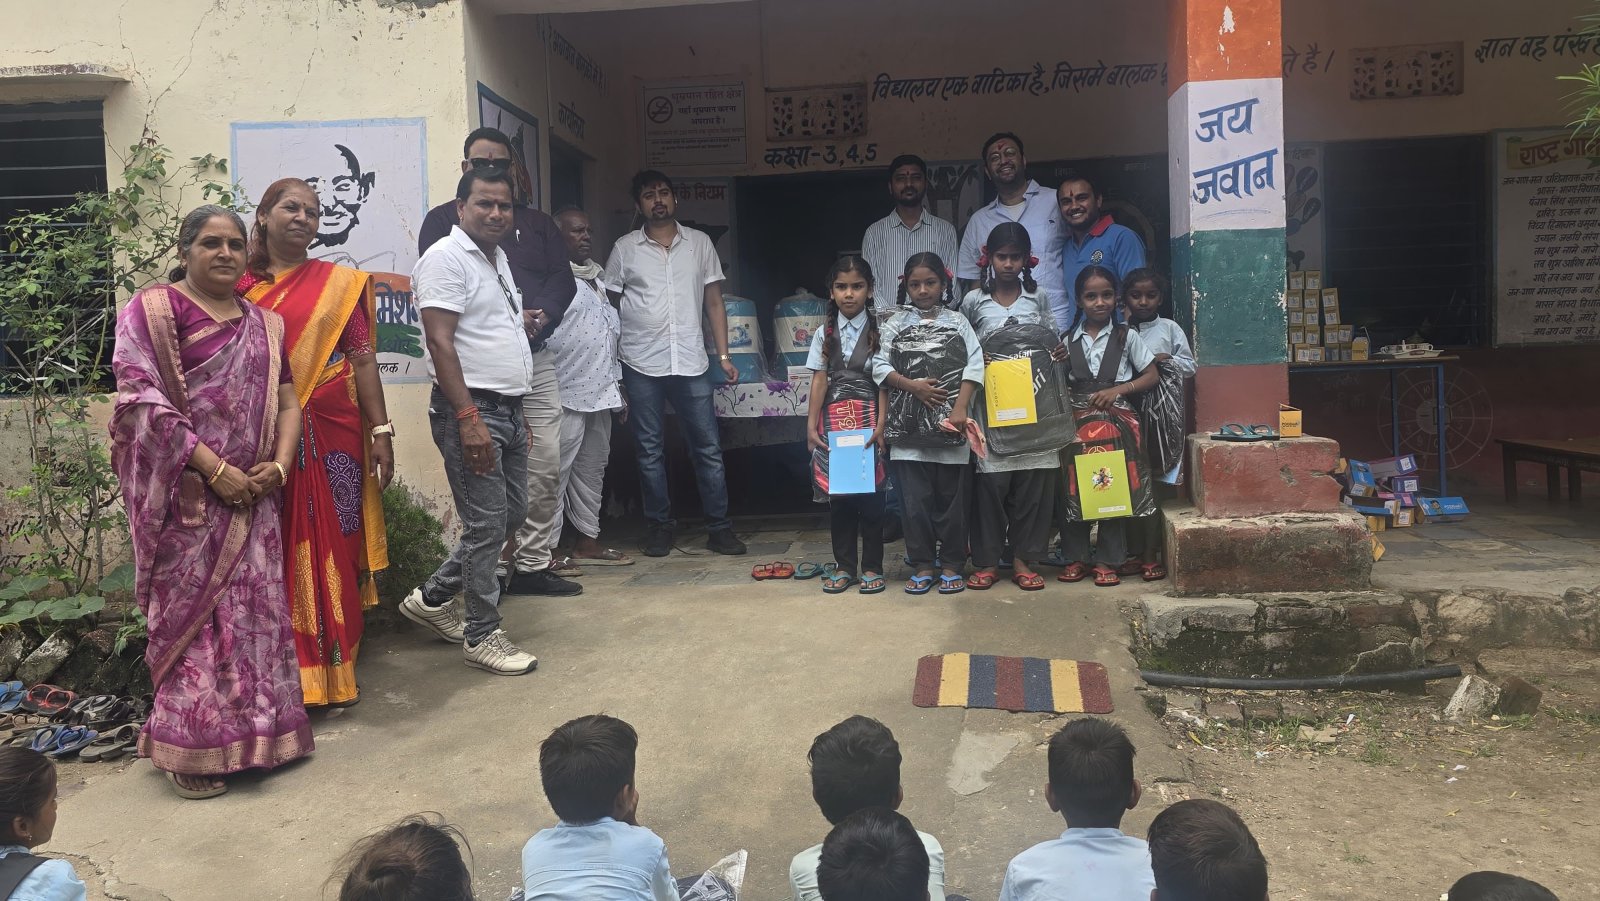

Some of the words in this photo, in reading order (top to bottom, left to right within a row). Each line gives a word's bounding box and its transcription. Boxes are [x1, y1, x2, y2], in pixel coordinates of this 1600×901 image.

[1475, 37, 1520, 63] ज्ञान
[1520, 35, 1550, 62] वह
[871, 72, 938, 103] विद्यालय
[941, 76, 968, 101] एक
[972, 67, 1026, 96] वाटिका
[1107, 63, 1160, 89] बालक
[1195, 97, 1260, 143] जय
[1519, 140, 1560, 166] राष्ट्र
[695, 182, 727, 201] नियम
[1192, 147, 1278, 205] जवान
